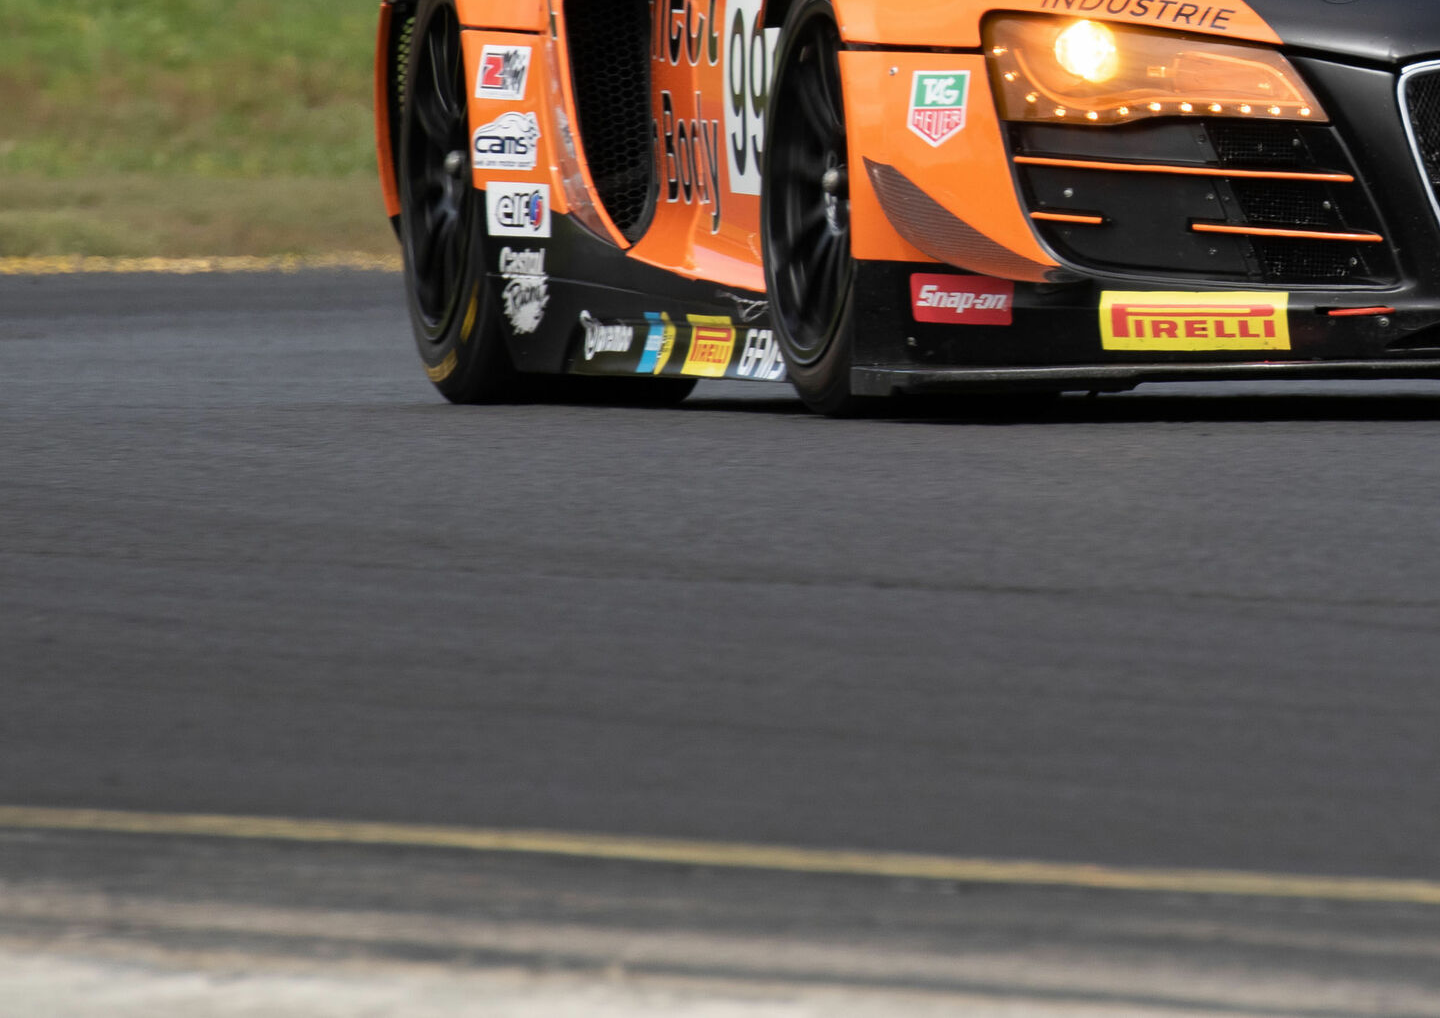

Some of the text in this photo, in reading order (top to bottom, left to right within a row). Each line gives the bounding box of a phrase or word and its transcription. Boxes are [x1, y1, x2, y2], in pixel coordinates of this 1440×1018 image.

[729, 6, 780, 177] 99
[922, 76, 960, 105] TAG
[912, 109, 962, 140] HEUER
[916, 284, 1008, 313] Snap-on
[1110, 303, 1277, 339] PIRELLI
